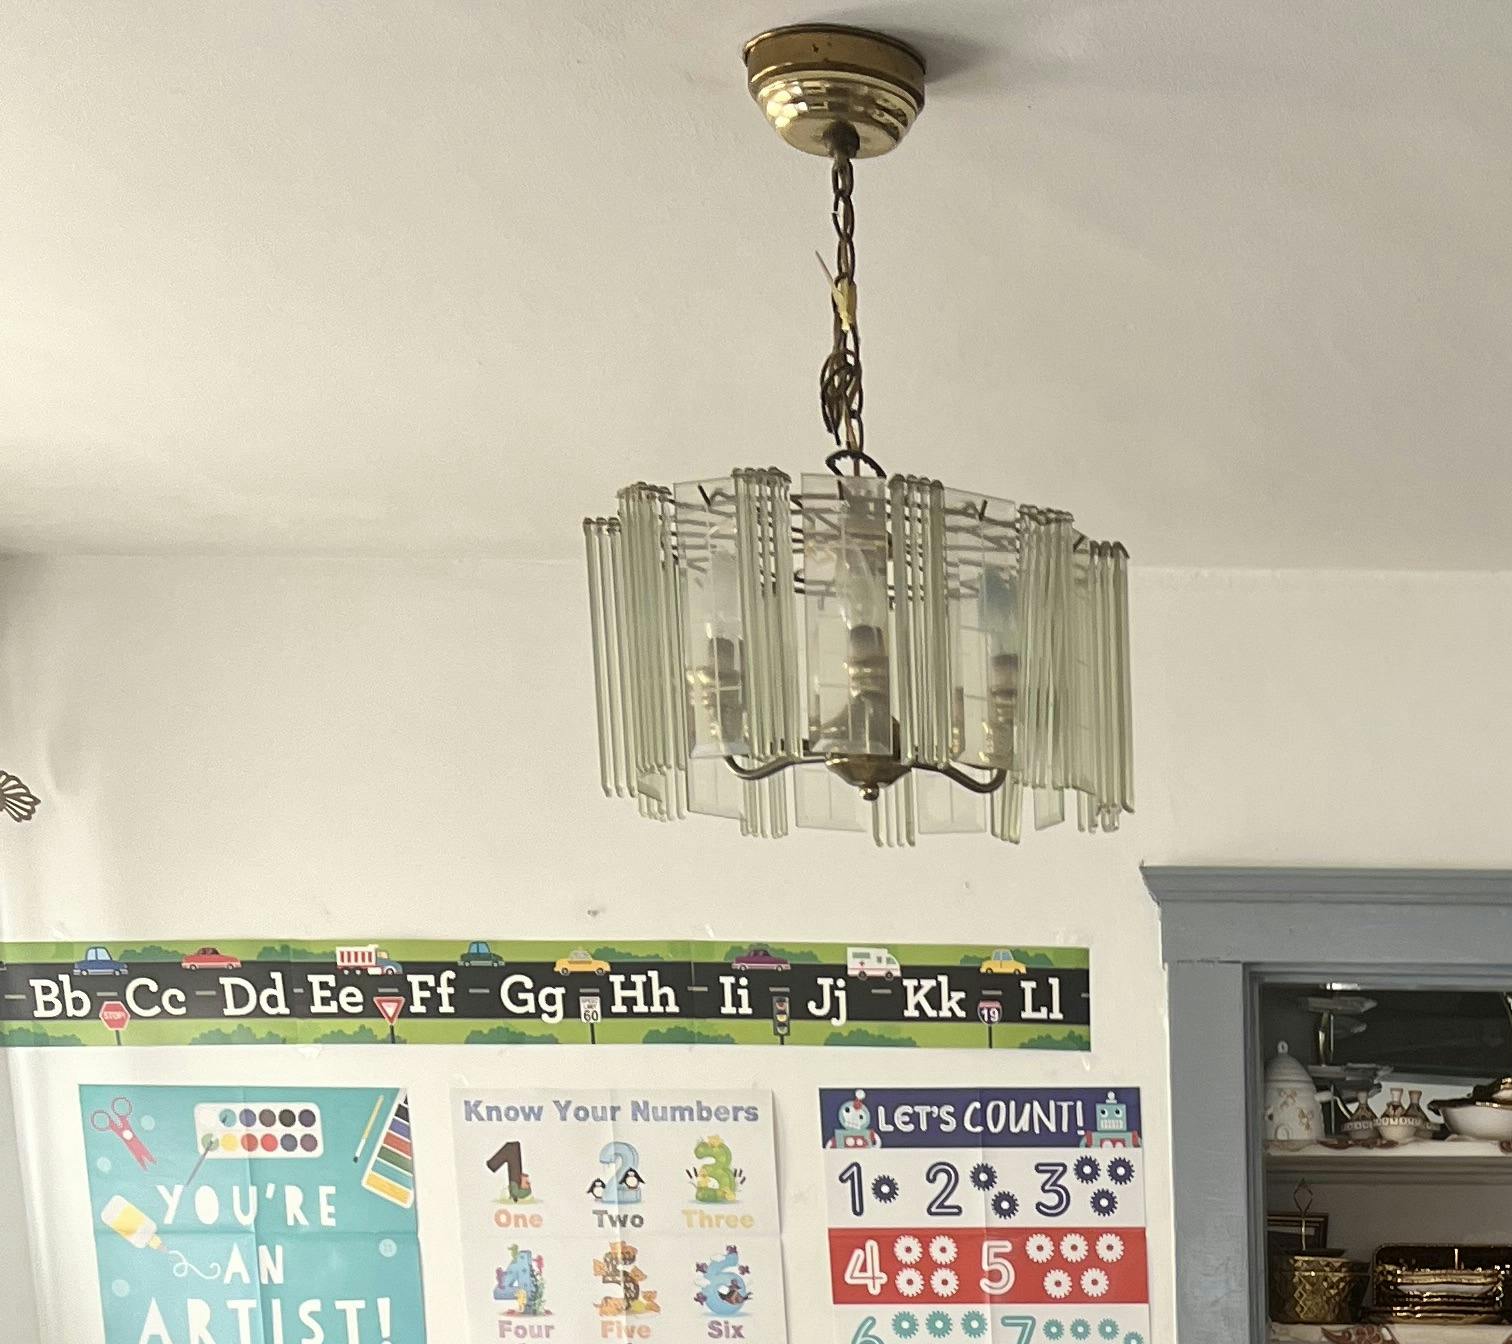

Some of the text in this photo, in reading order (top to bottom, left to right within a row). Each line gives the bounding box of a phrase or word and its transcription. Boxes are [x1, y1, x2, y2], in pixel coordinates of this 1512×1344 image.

[28, 970, 1063, 1026] Bb Cc Dd Ee Ff Gg Hh Ii Jj Kk Ll
[464, 1100, 760, 1122] Know Your Numbers
[877, 1100, 1084, 1135] LET'S COUNT!
[157, 1184, 336, 1226] YOU'RE
[839, 1161, 864, 1217] 1
[925, 1161, 963, 1217] 2
[1034, 1162, 1071, 1217] 3
[494, 1210, 543, 1229] One
[592, 1210, 644, 1229] Two
[681, 1209, 755, 1229] Three
[223, 1244, 284, 1285] AN
[844, 1239, 888, 1296] 4
[979, 1240, 1016, 1296] 5
[498, 1321, 554, 1339] Four
[601, 1320, 652, 1340] Five
[707, 1319, 745, 1340] Six
